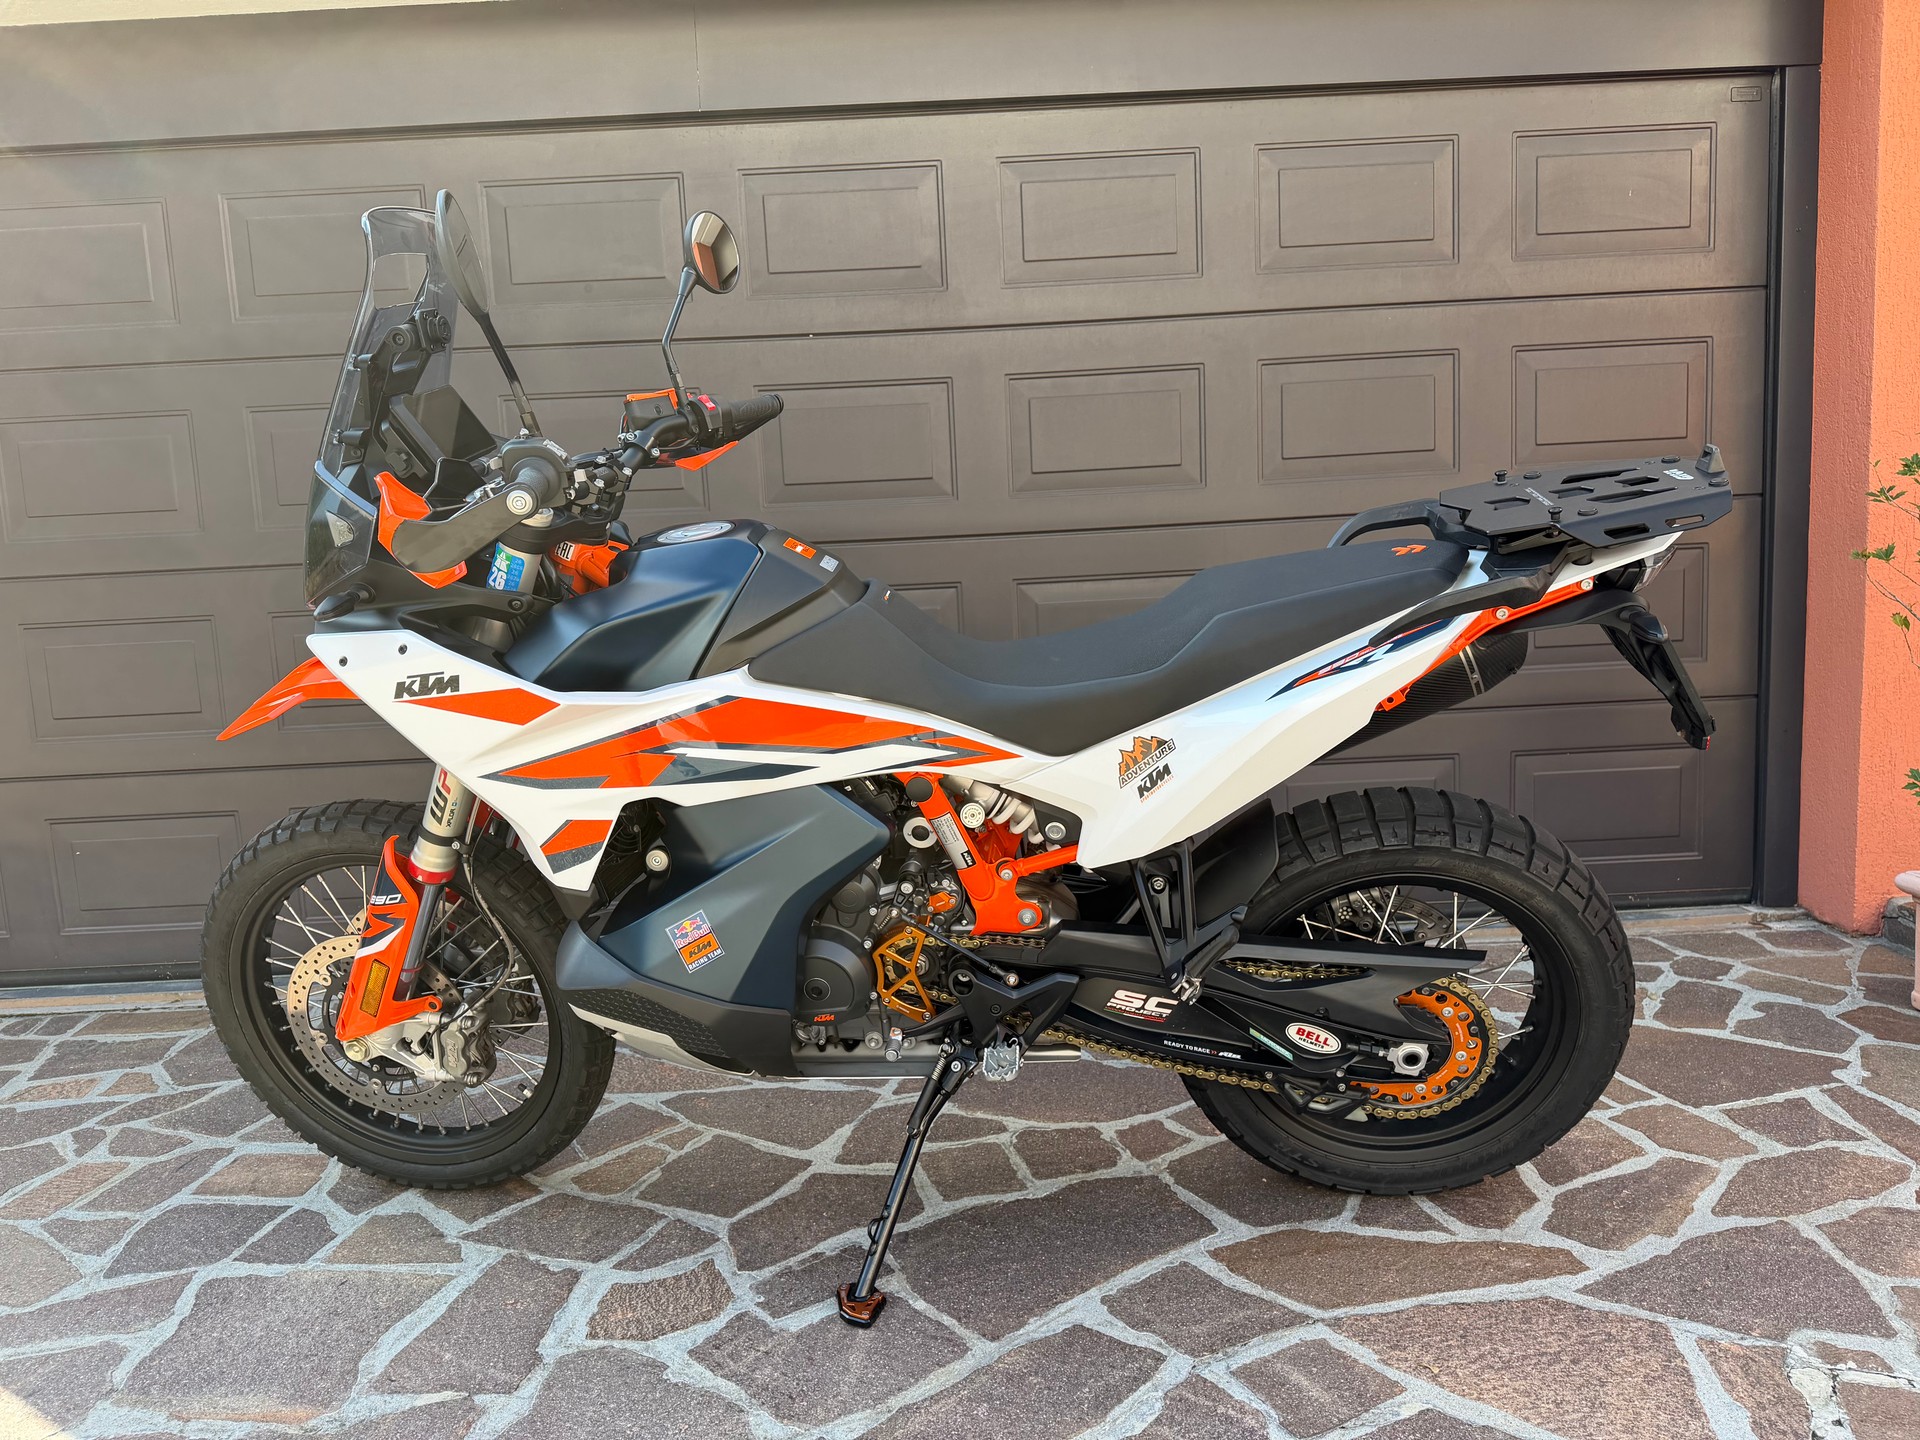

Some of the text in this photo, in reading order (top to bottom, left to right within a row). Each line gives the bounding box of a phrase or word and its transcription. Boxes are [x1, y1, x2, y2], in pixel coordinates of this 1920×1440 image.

[488, 567, 507, 590] 26
[394, 671, 460, 699] KTM
[1121, 741, 1174, 785] ADVENTURE
[1137, 763, 1172, 799] KTM
[429, 767, 451, 826] WP
[675, 923, 711, 949] Red Bull
[688, 940, 712, 958] KTM
[688, 949, 722, 970] RACING TEAM
[1106, 1002, 1170, 1018] PROJECT
[1109, 989, 1179, 1014] SC
[813, 1013, 835, 1022] KTM
[1163, 1040, 1185, 1049] READY
[1194, 1046, 1211, 1054] RACE
[1295, 1027, 1331, 1047] BELL
[1298, 1037, 1324, 1049] HELMETS
